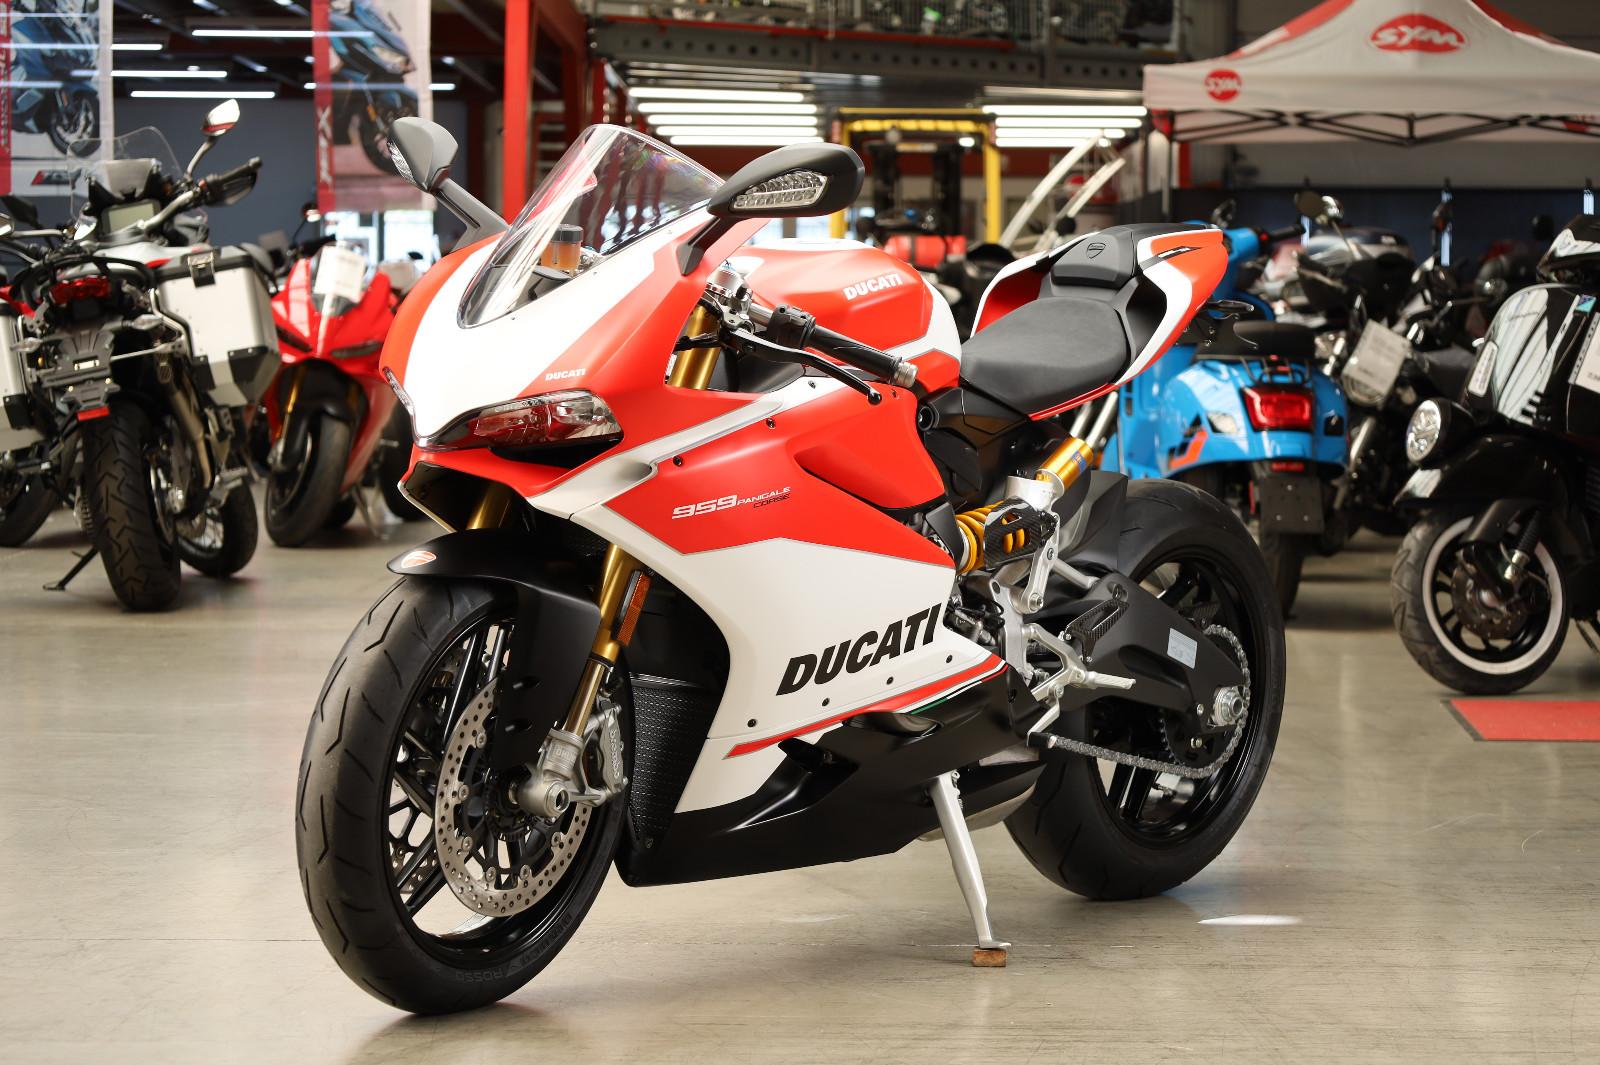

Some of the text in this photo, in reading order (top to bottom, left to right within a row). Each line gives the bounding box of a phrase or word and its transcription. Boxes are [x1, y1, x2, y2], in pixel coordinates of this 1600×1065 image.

[843, 273, 903, 301] DUCATI
[544, 368, 586, 381] DUCATI
[671, 486, 791, 519] 959 PANIGALE
[753, 493, 790, 509] CORSE
[776, 602, 942, 696] DUCATI
